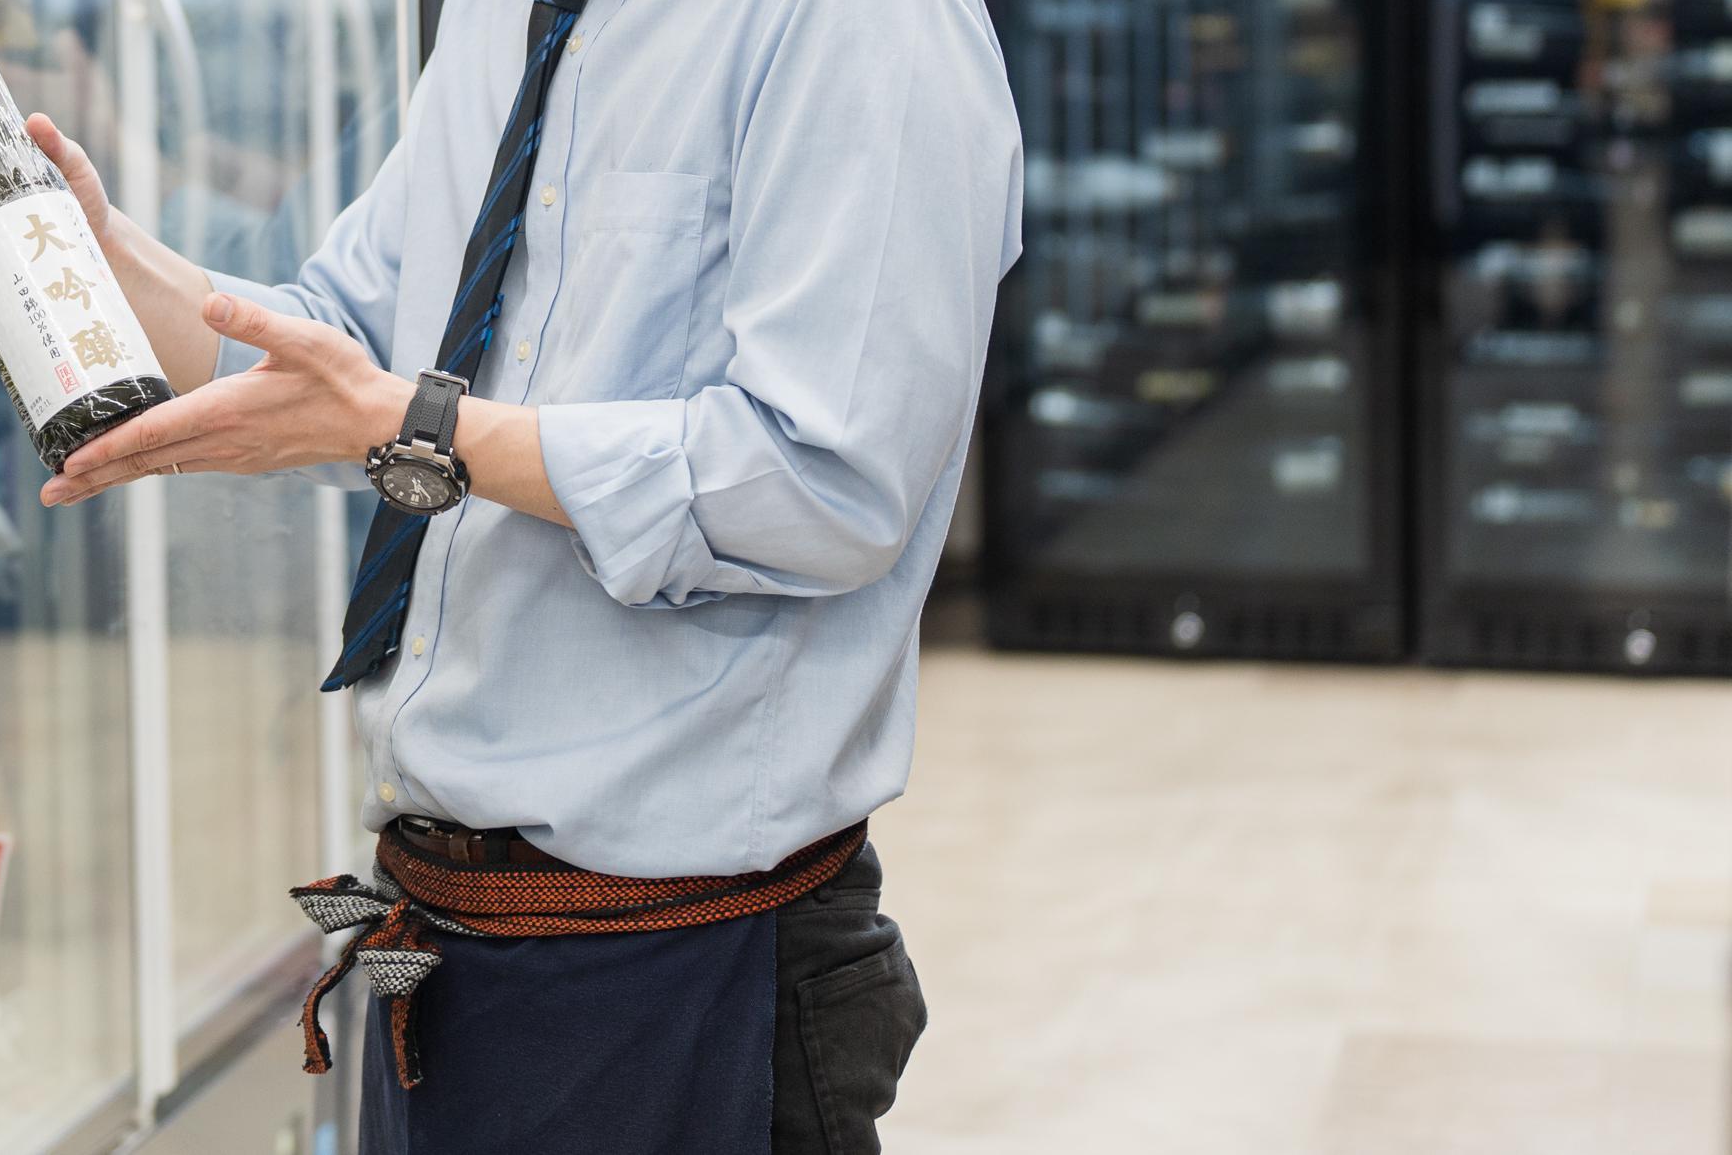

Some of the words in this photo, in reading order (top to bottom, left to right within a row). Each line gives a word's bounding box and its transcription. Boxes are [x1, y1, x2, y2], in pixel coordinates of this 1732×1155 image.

[13, 273, 61, 359] 山田錦100%使用
[23, 214, 134, 370] 大吟醸
